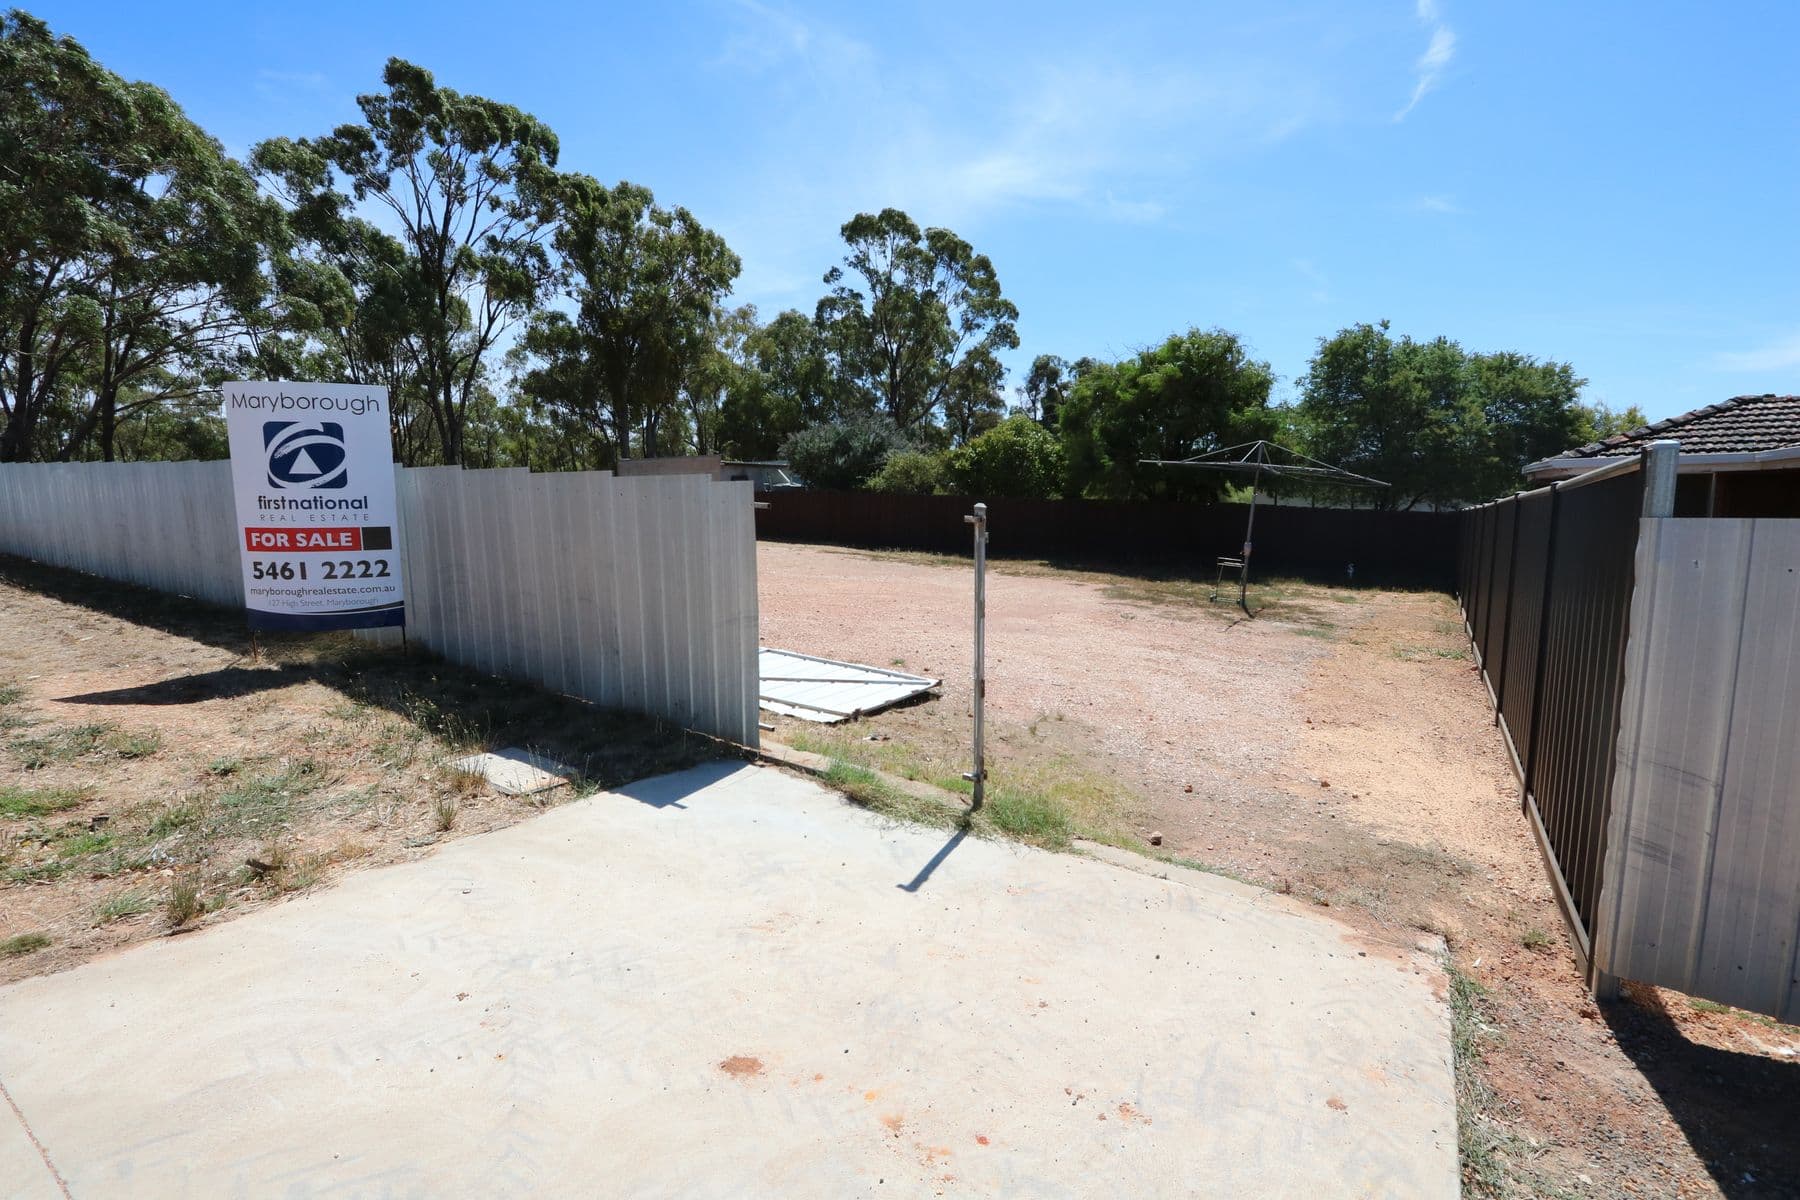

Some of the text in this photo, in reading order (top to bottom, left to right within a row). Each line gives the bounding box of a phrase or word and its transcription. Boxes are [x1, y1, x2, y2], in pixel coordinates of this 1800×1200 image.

[231, 392, 380, 416] Maryborough
[257, 495, 368, 510] firstnational
[260, 513, 369, 522] REAL ESTATE
[251, 532, 353, 547] FOR SALE
[252, 559, 391, 580] 5461 2222
[250, 585, 396, 598] maryboroughrealestate.com.au
[326, 598, 379, 608] Maryborough
